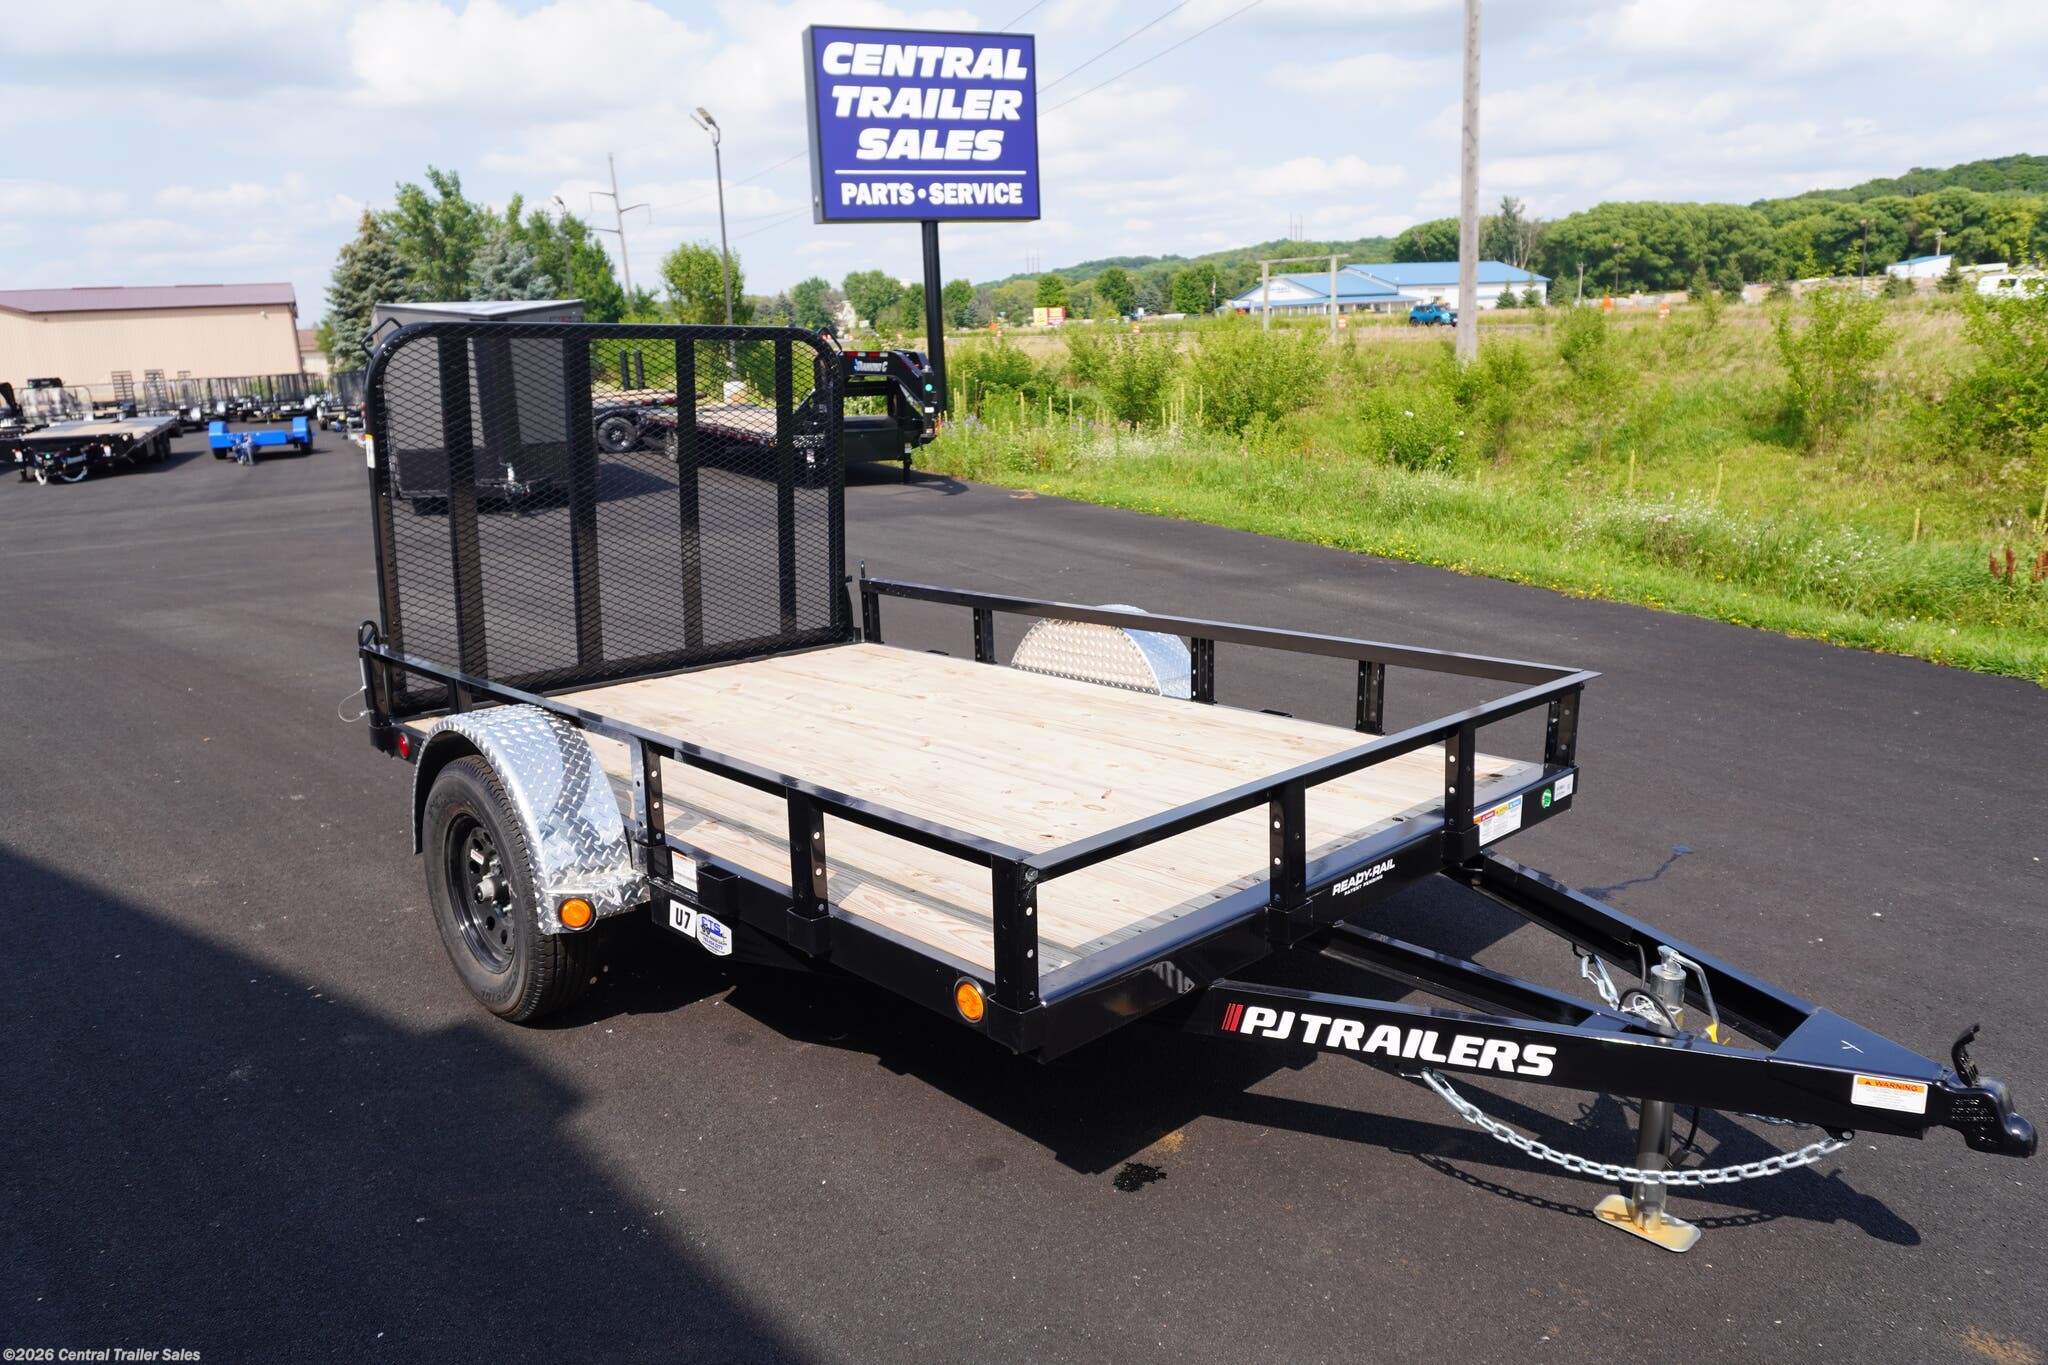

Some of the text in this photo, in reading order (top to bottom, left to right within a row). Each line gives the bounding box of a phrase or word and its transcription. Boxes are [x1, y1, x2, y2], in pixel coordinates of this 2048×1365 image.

[822, 41, 1028, 80] CENTRAL
[831, 85, 1023, 120] TRAILER
[855, 127, 1005, 161] SALES
[841, 182, 1023, 205] PARTS SERVICE
[675, 907, 691, 929] U7
[1240, 1006, 1557, 1077] PJ TRAILERS
[1875, 1080, 1918, 1092] WARNING
